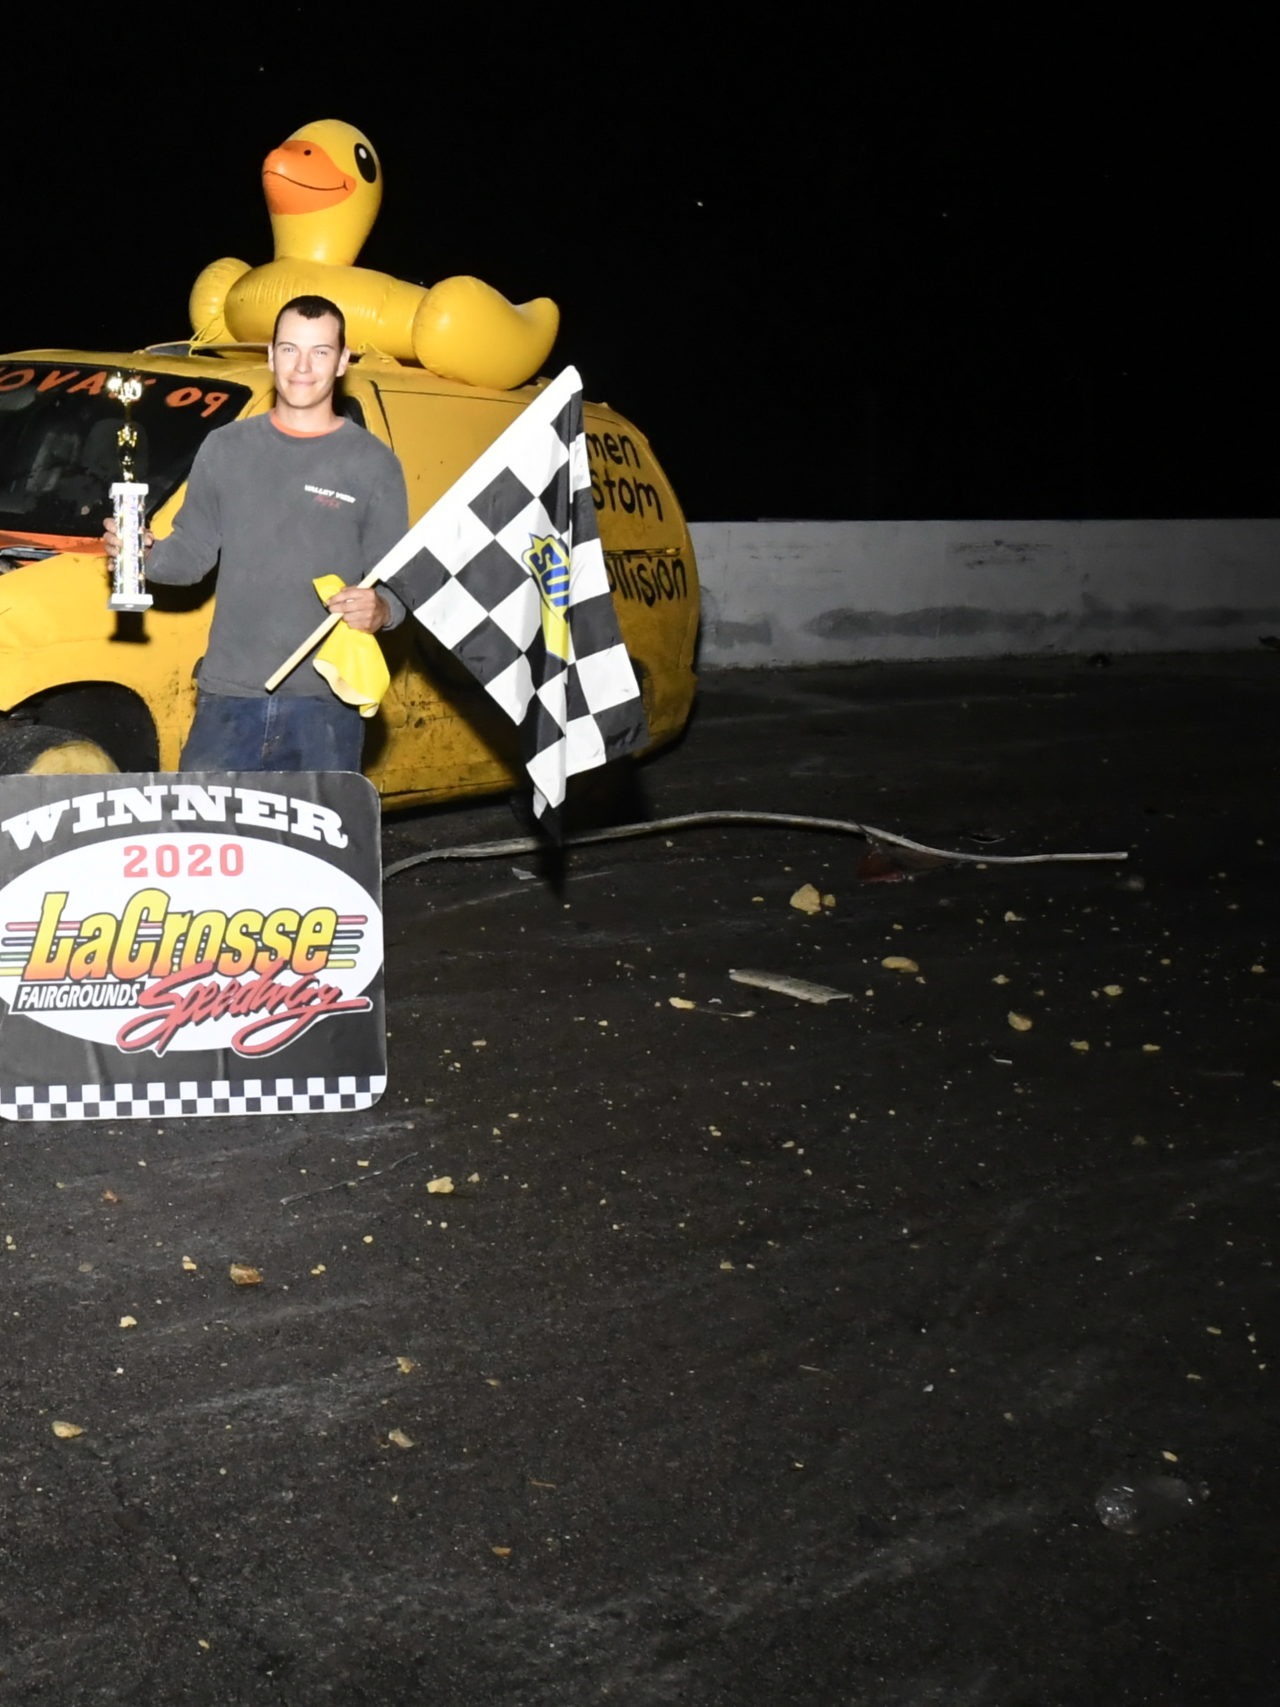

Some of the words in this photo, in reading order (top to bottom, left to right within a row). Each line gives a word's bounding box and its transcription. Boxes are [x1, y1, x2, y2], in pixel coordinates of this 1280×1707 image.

[1, 784, 349, 850] WINNER
[122, 843, 244, 878] 2020
[22, 888, 339, 981] LaCrosse
[17, 983, 140, 1010] FAIRGROUNDS
[117, 958, 370, 1054] Speedway
